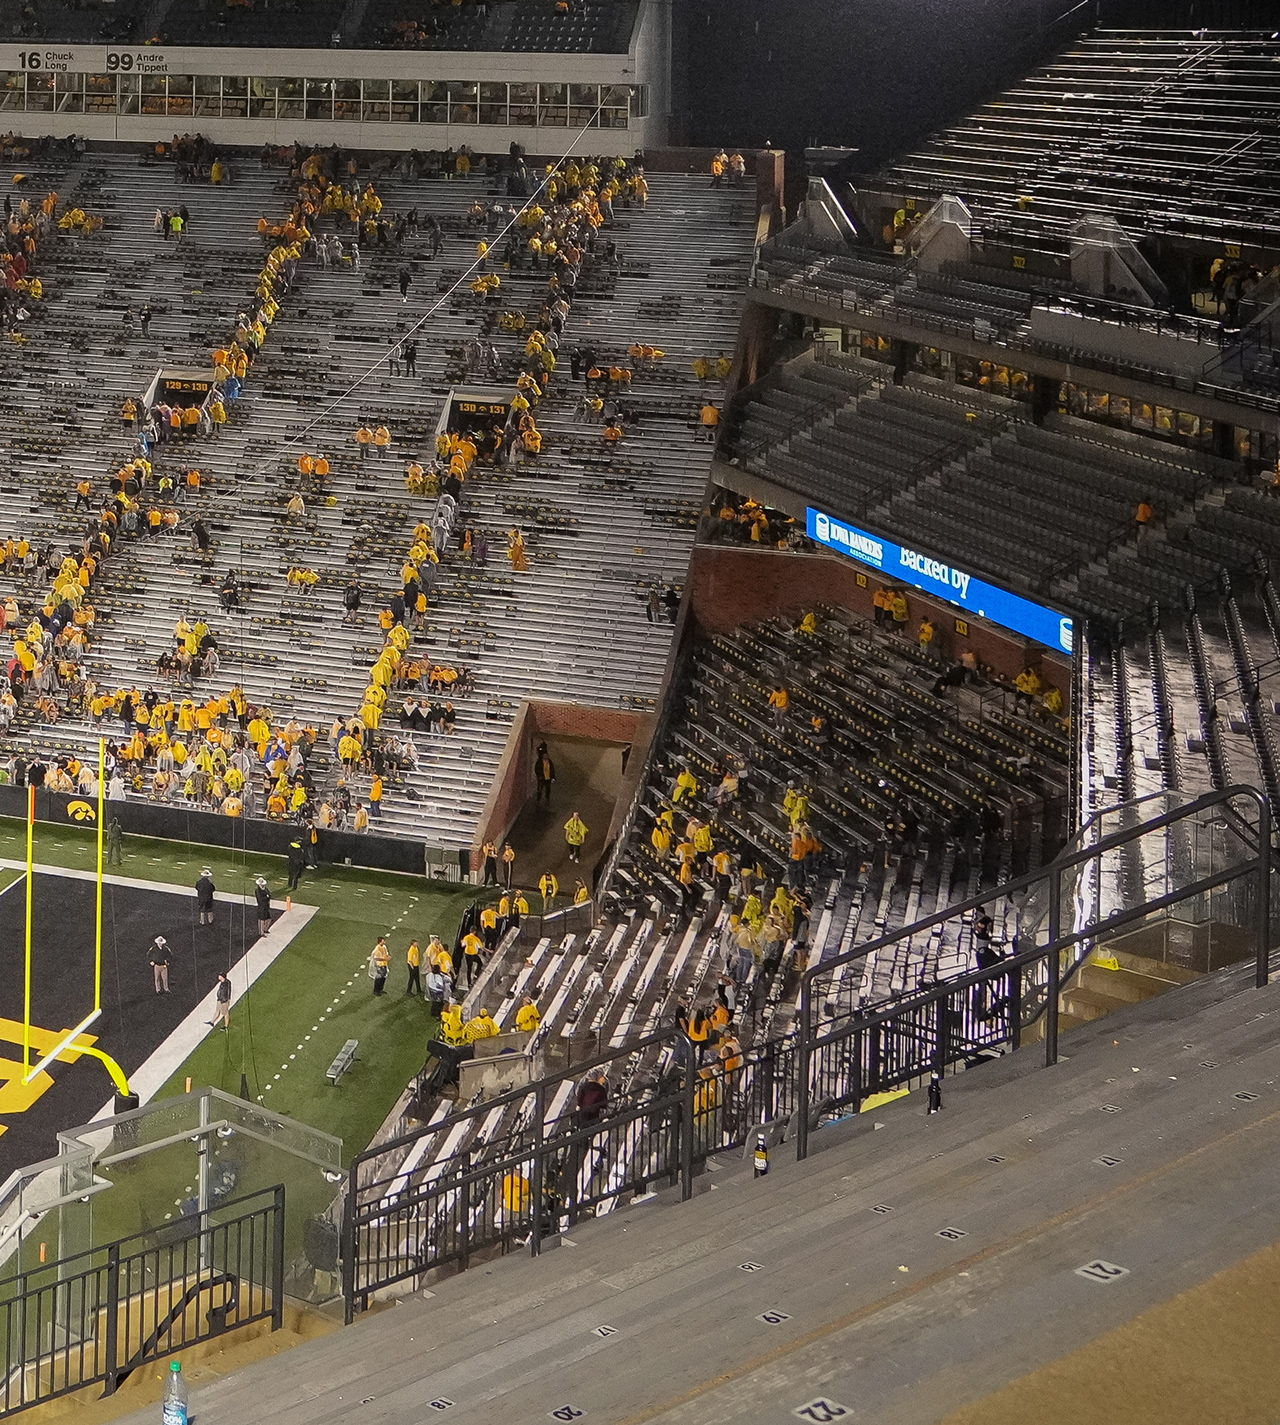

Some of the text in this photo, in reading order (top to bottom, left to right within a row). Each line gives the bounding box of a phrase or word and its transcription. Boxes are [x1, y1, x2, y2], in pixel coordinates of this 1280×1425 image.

[18, 52, 41, 69] 16
[45, 52, 74, 60] Chuck
[136, 54, 164, 62] Andre
[45, 62, 67, 71] Long
[107, 53, 134, 71] 99
[136, 63, 168, 72] Tippett
[165, 381, 208, 391] 129 130
[459, 403, 505, 414] 130 131
[873, 1204, 892, 1213] 15
[940, 1228, 965, 1239] 18
[741, 1262, 761, 1271] 16
[1082, 1263, 1121, 1280] 21
[762, 1311, 789, 1324] 19
[597, 1326, 617, 1337] 17
[430, 1398, 452, 1411] 18
[552, 1405, 582, 1421] 20
[800, 1400, 846, 1422] 22
